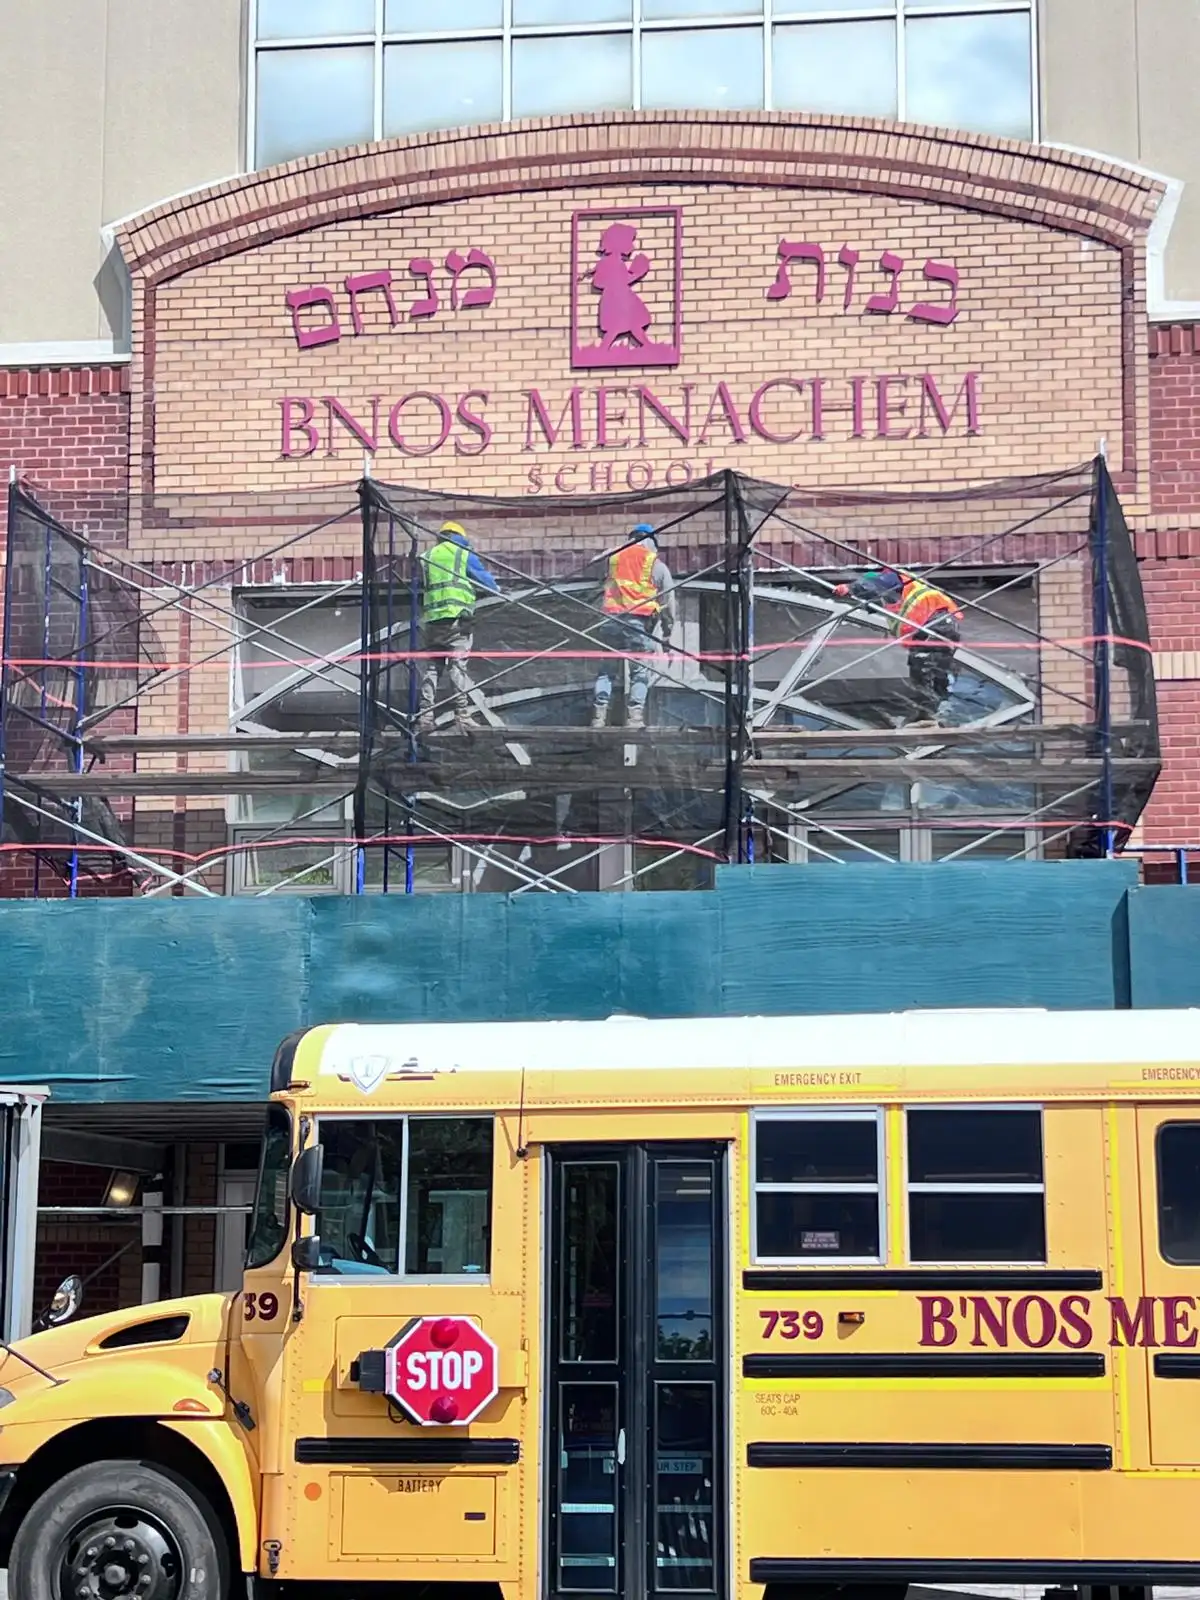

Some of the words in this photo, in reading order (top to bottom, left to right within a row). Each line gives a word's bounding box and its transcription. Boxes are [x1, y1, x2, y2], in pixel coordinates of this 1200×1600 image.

[286, 248, 496, 349] מנחם
[766, 238, 960, 326] בנות
[277, 390, 492, 460] BNOS
[522, 371, 983, 451] MENACHEM
[774, 1072, 837, 1086] EMERGENCY
[839, 1072, 862, 1085] EXIT
[758, 1310, 824, 1340] 739
[915, 1294, 1093, 1349] B'NOS
[1103, 1295, 1200, 1348] ME
[406, 1350, 484, 1391] STOP
[397, 1479, 443, 1494] BATTERY
[673, 1461, 697, 1472] STEP
